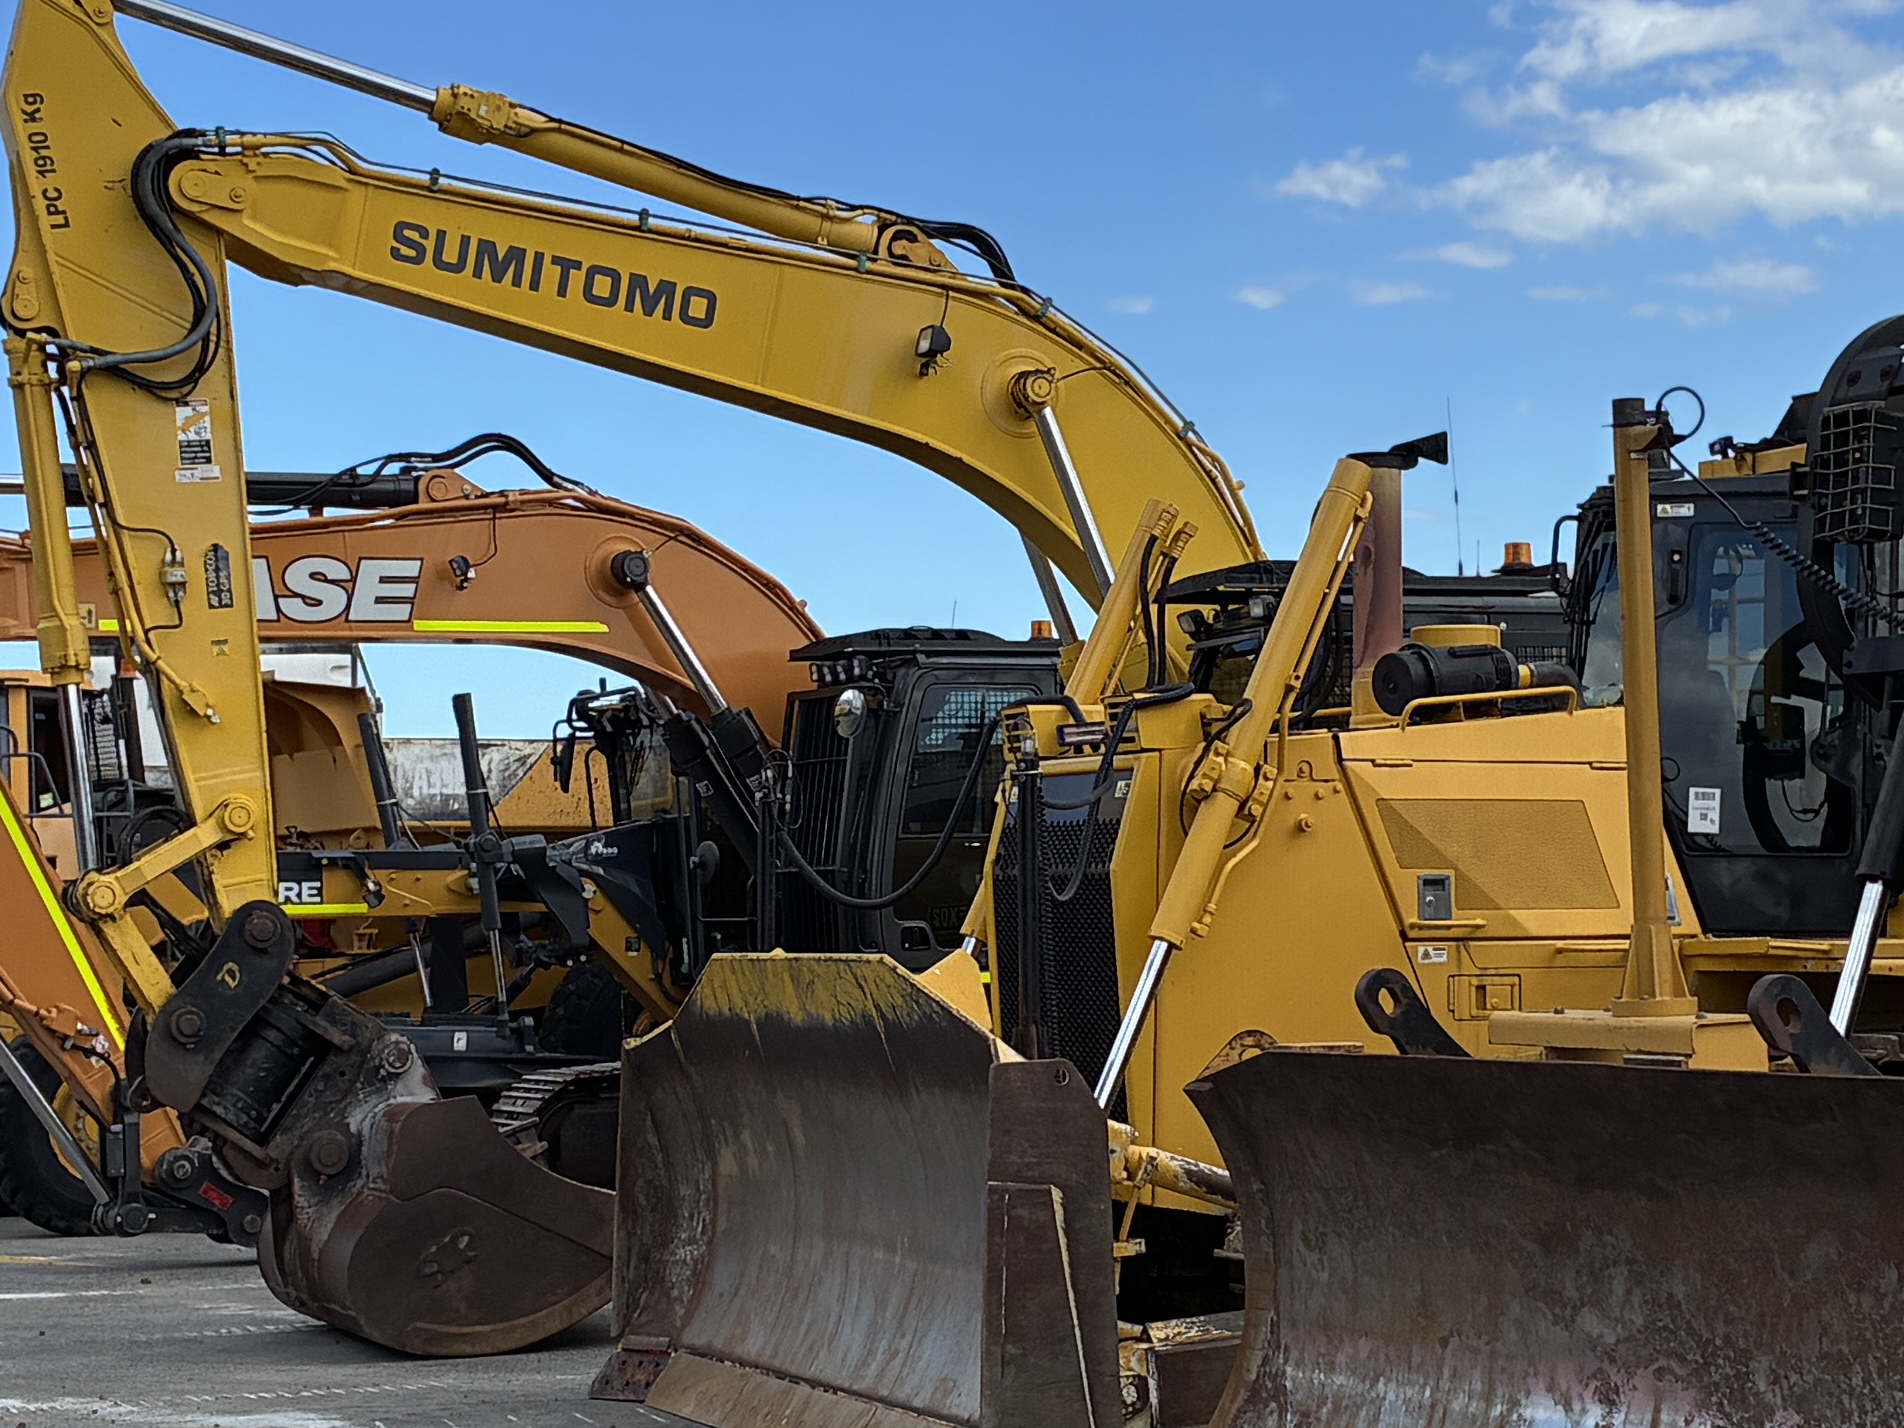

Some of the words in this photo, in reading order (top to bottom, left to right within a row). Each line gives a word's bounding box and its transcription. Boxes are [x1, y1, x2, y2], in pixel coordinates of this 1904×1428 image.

[20, 92, 45, 124] Kg
[27, 131, 57, 179] 1910
[41, 186, 71, 230] LPC
[389, 220, 718, 330] SUMITOMO
